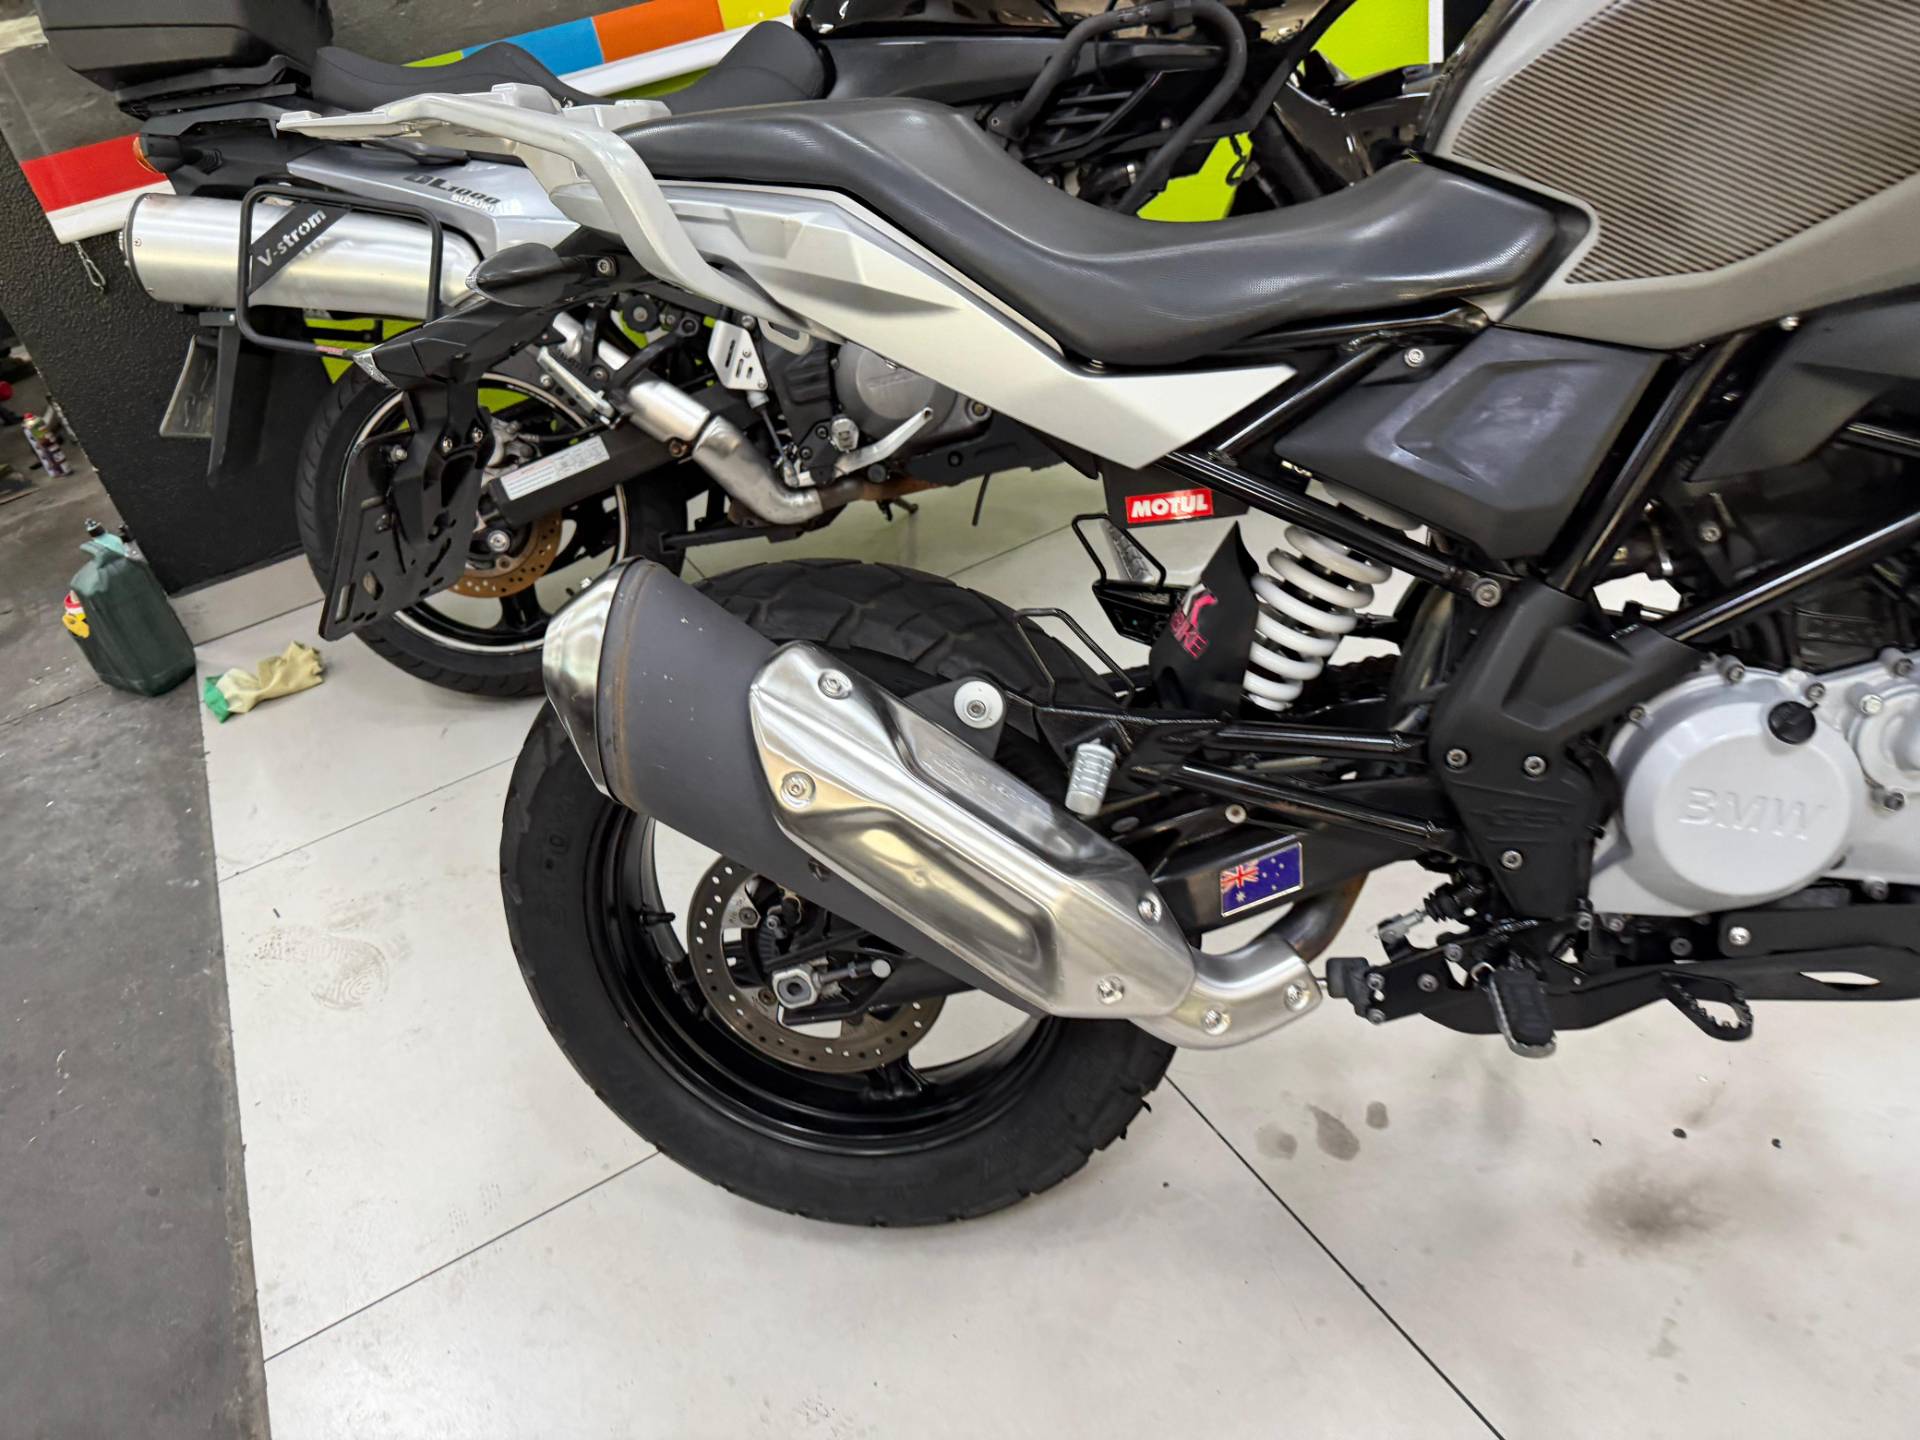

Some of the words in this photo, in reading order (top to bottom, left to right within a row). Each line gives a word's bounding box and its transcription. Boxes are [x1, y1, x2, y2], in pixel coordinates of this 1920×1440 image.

[451, 194, 497, 213] SUZUKI
[257, 209, 327, 267] V-strom
[1131, 494, 1208, 518] MOTUL
[1679, 786, 1828, 840] BMW
